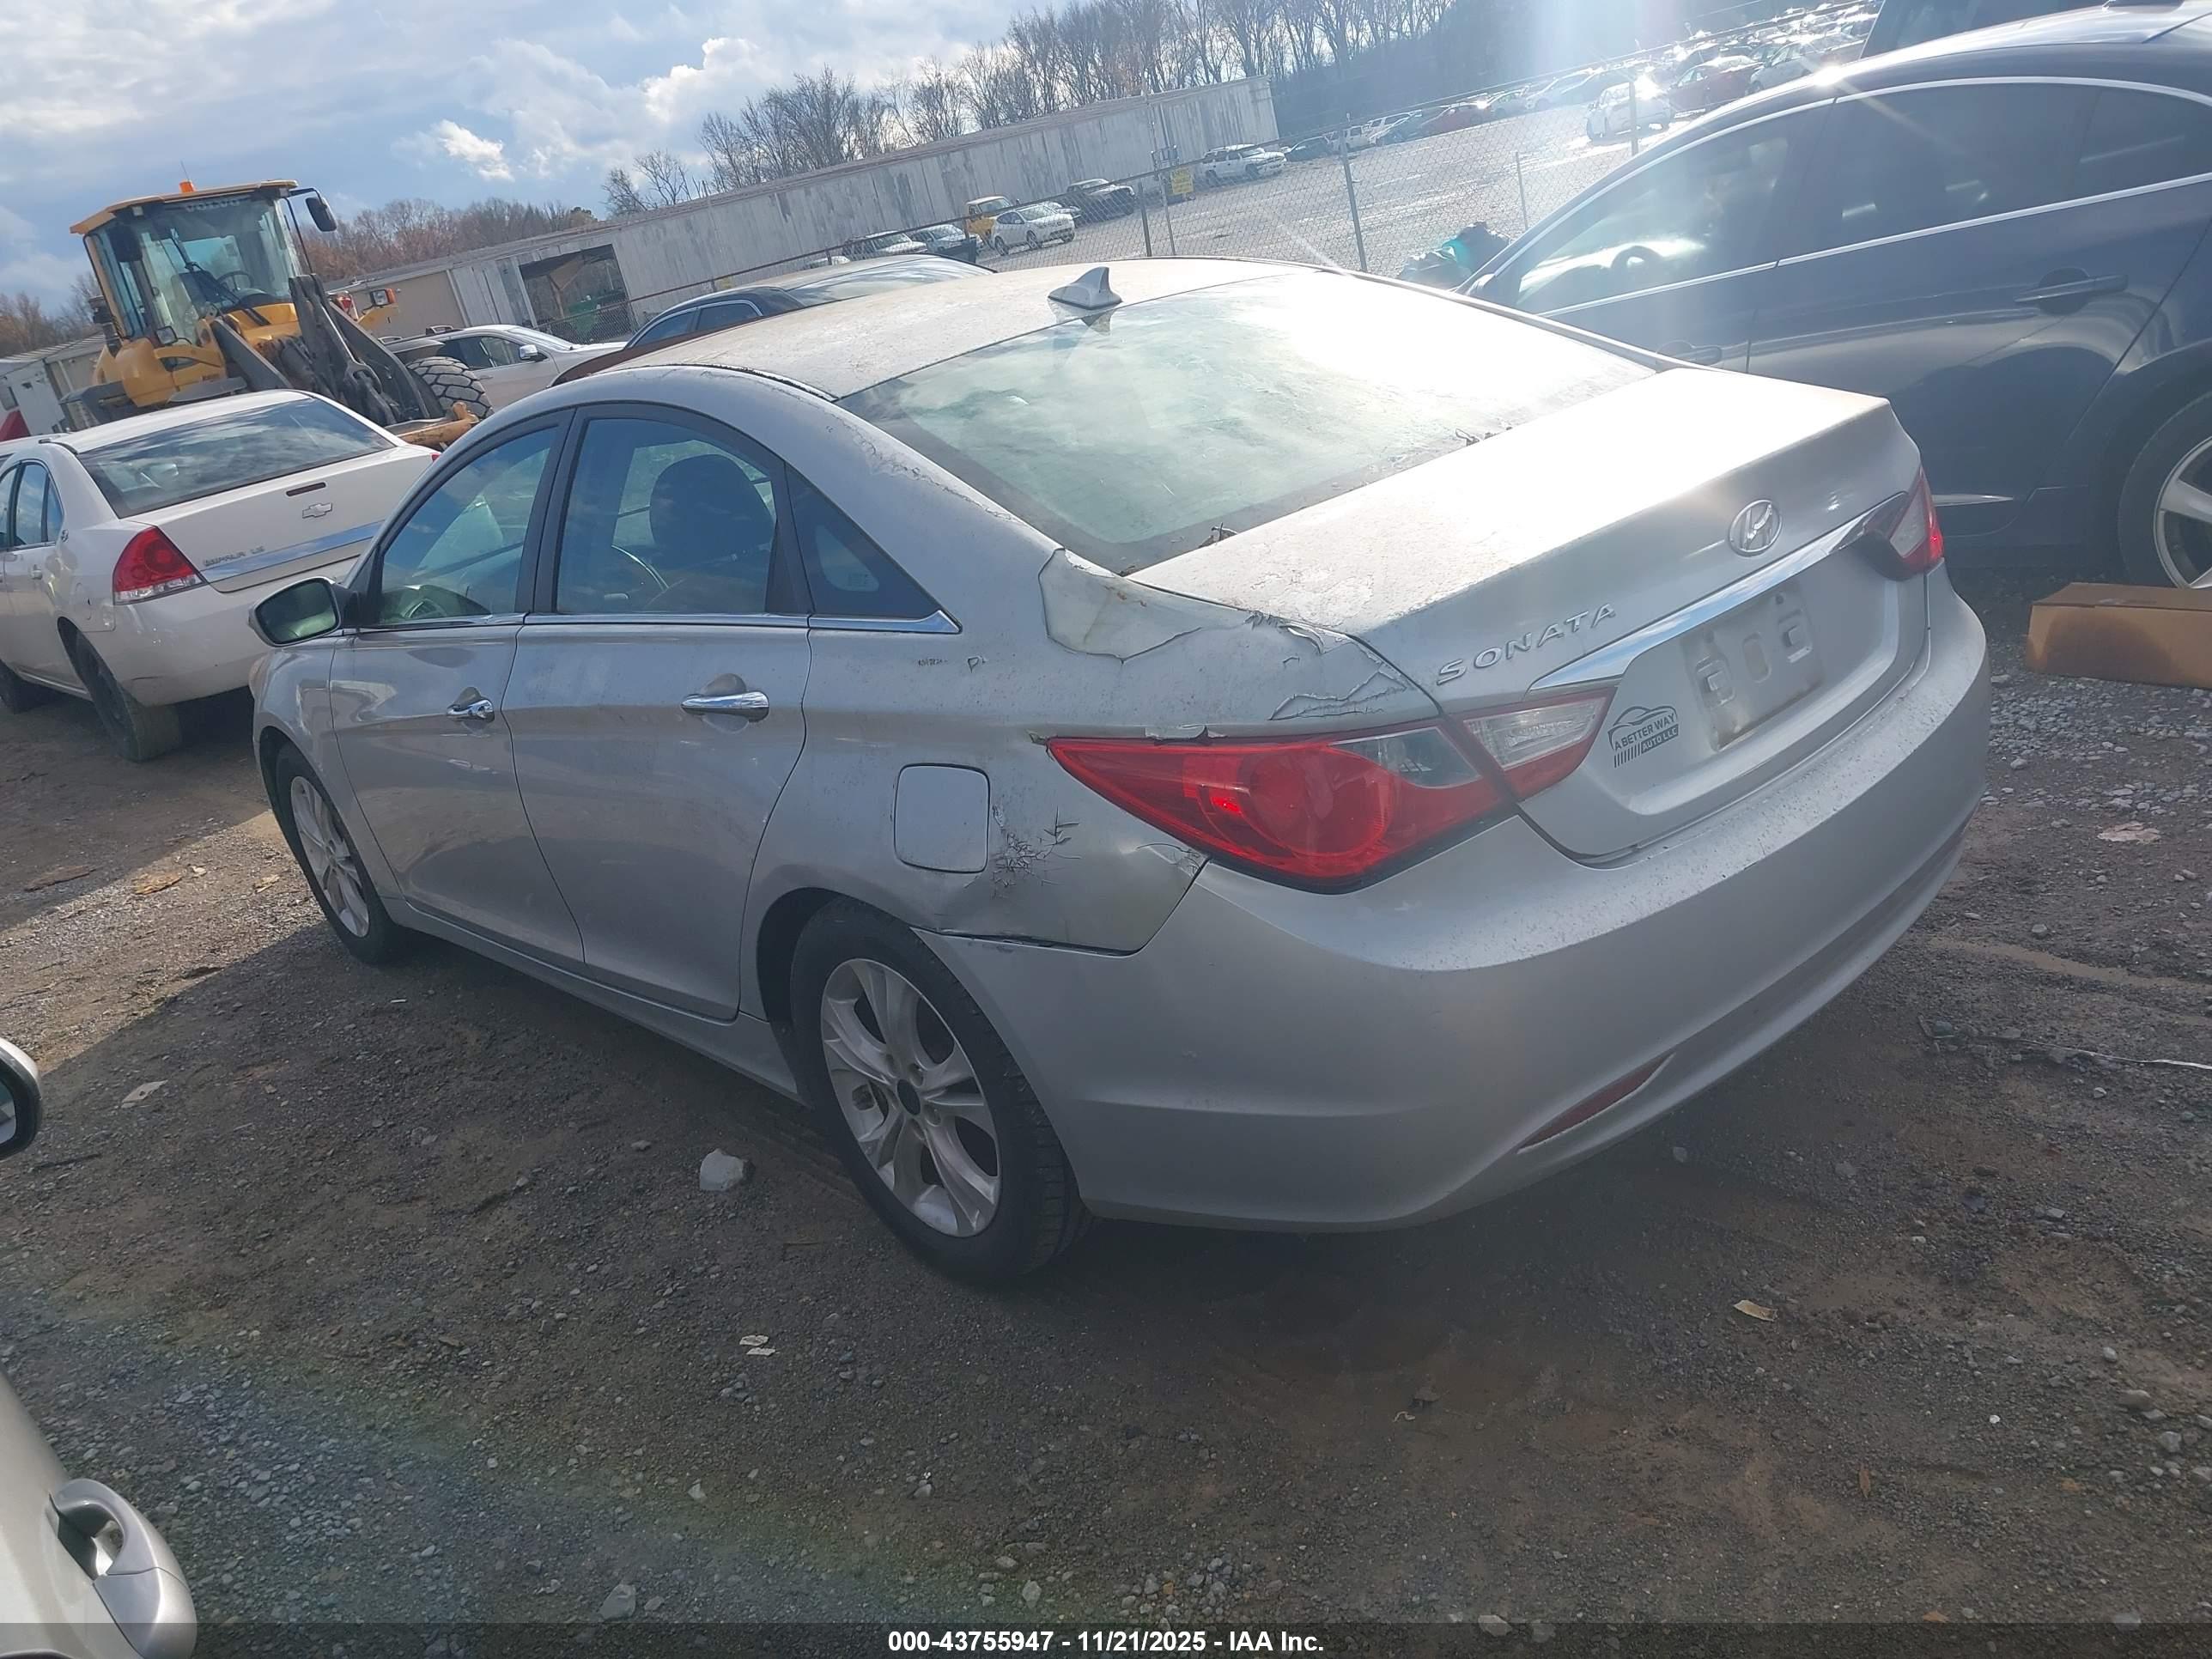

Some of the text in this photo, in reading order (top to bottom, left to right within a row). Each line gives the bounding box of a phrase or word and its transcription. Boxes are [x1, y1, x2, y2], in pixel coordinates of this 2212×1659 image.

[1437, 604, 1616, 685] SONATA
[1614, 713, 1674, 750] A BETTER WAY
[1641, 726, 1678, 751] AUTO LLC
